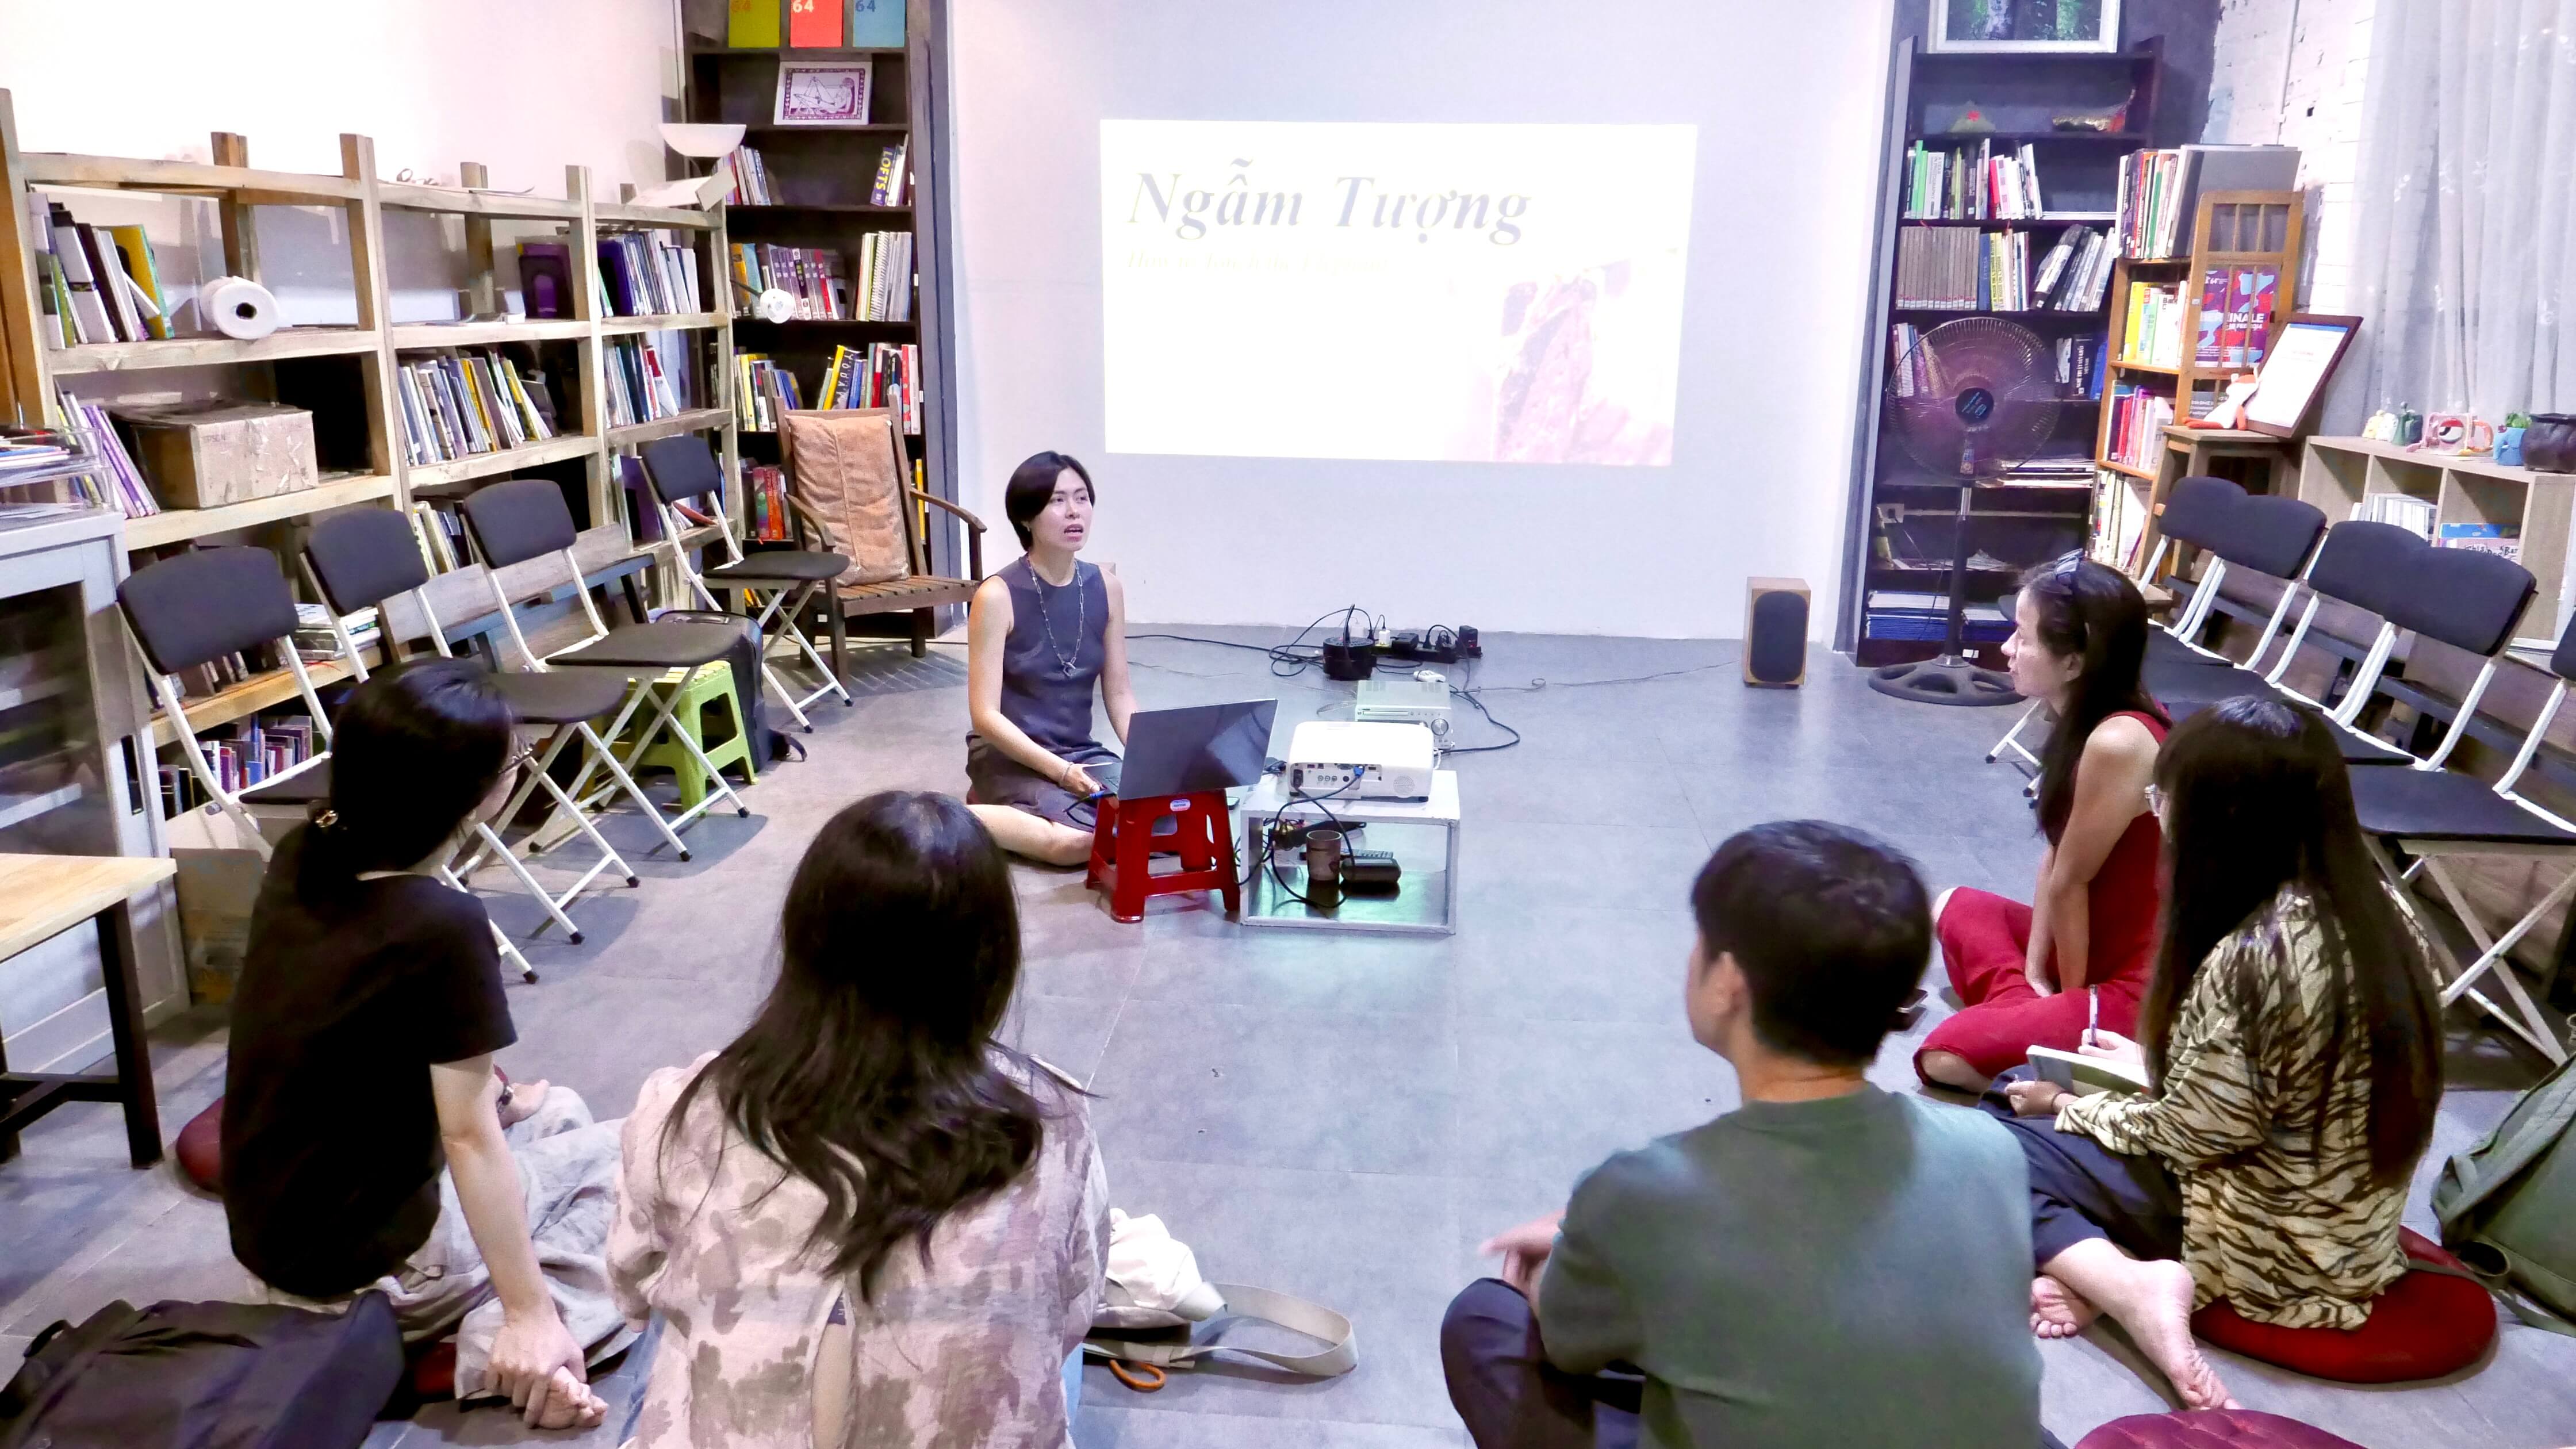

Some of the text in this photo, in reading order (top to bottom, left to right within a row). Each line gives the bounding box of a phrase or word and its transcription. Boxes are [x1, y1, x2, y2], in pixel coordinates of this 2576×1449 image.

[792, 0, 814, 13] 64
[855, 0, 876, 13] 64
[876, 152, 894, 190] LOFTS
[1128, 158, 1532, 246] Ngẫm Tượng
[837, 354, 852, 397] TODAY
